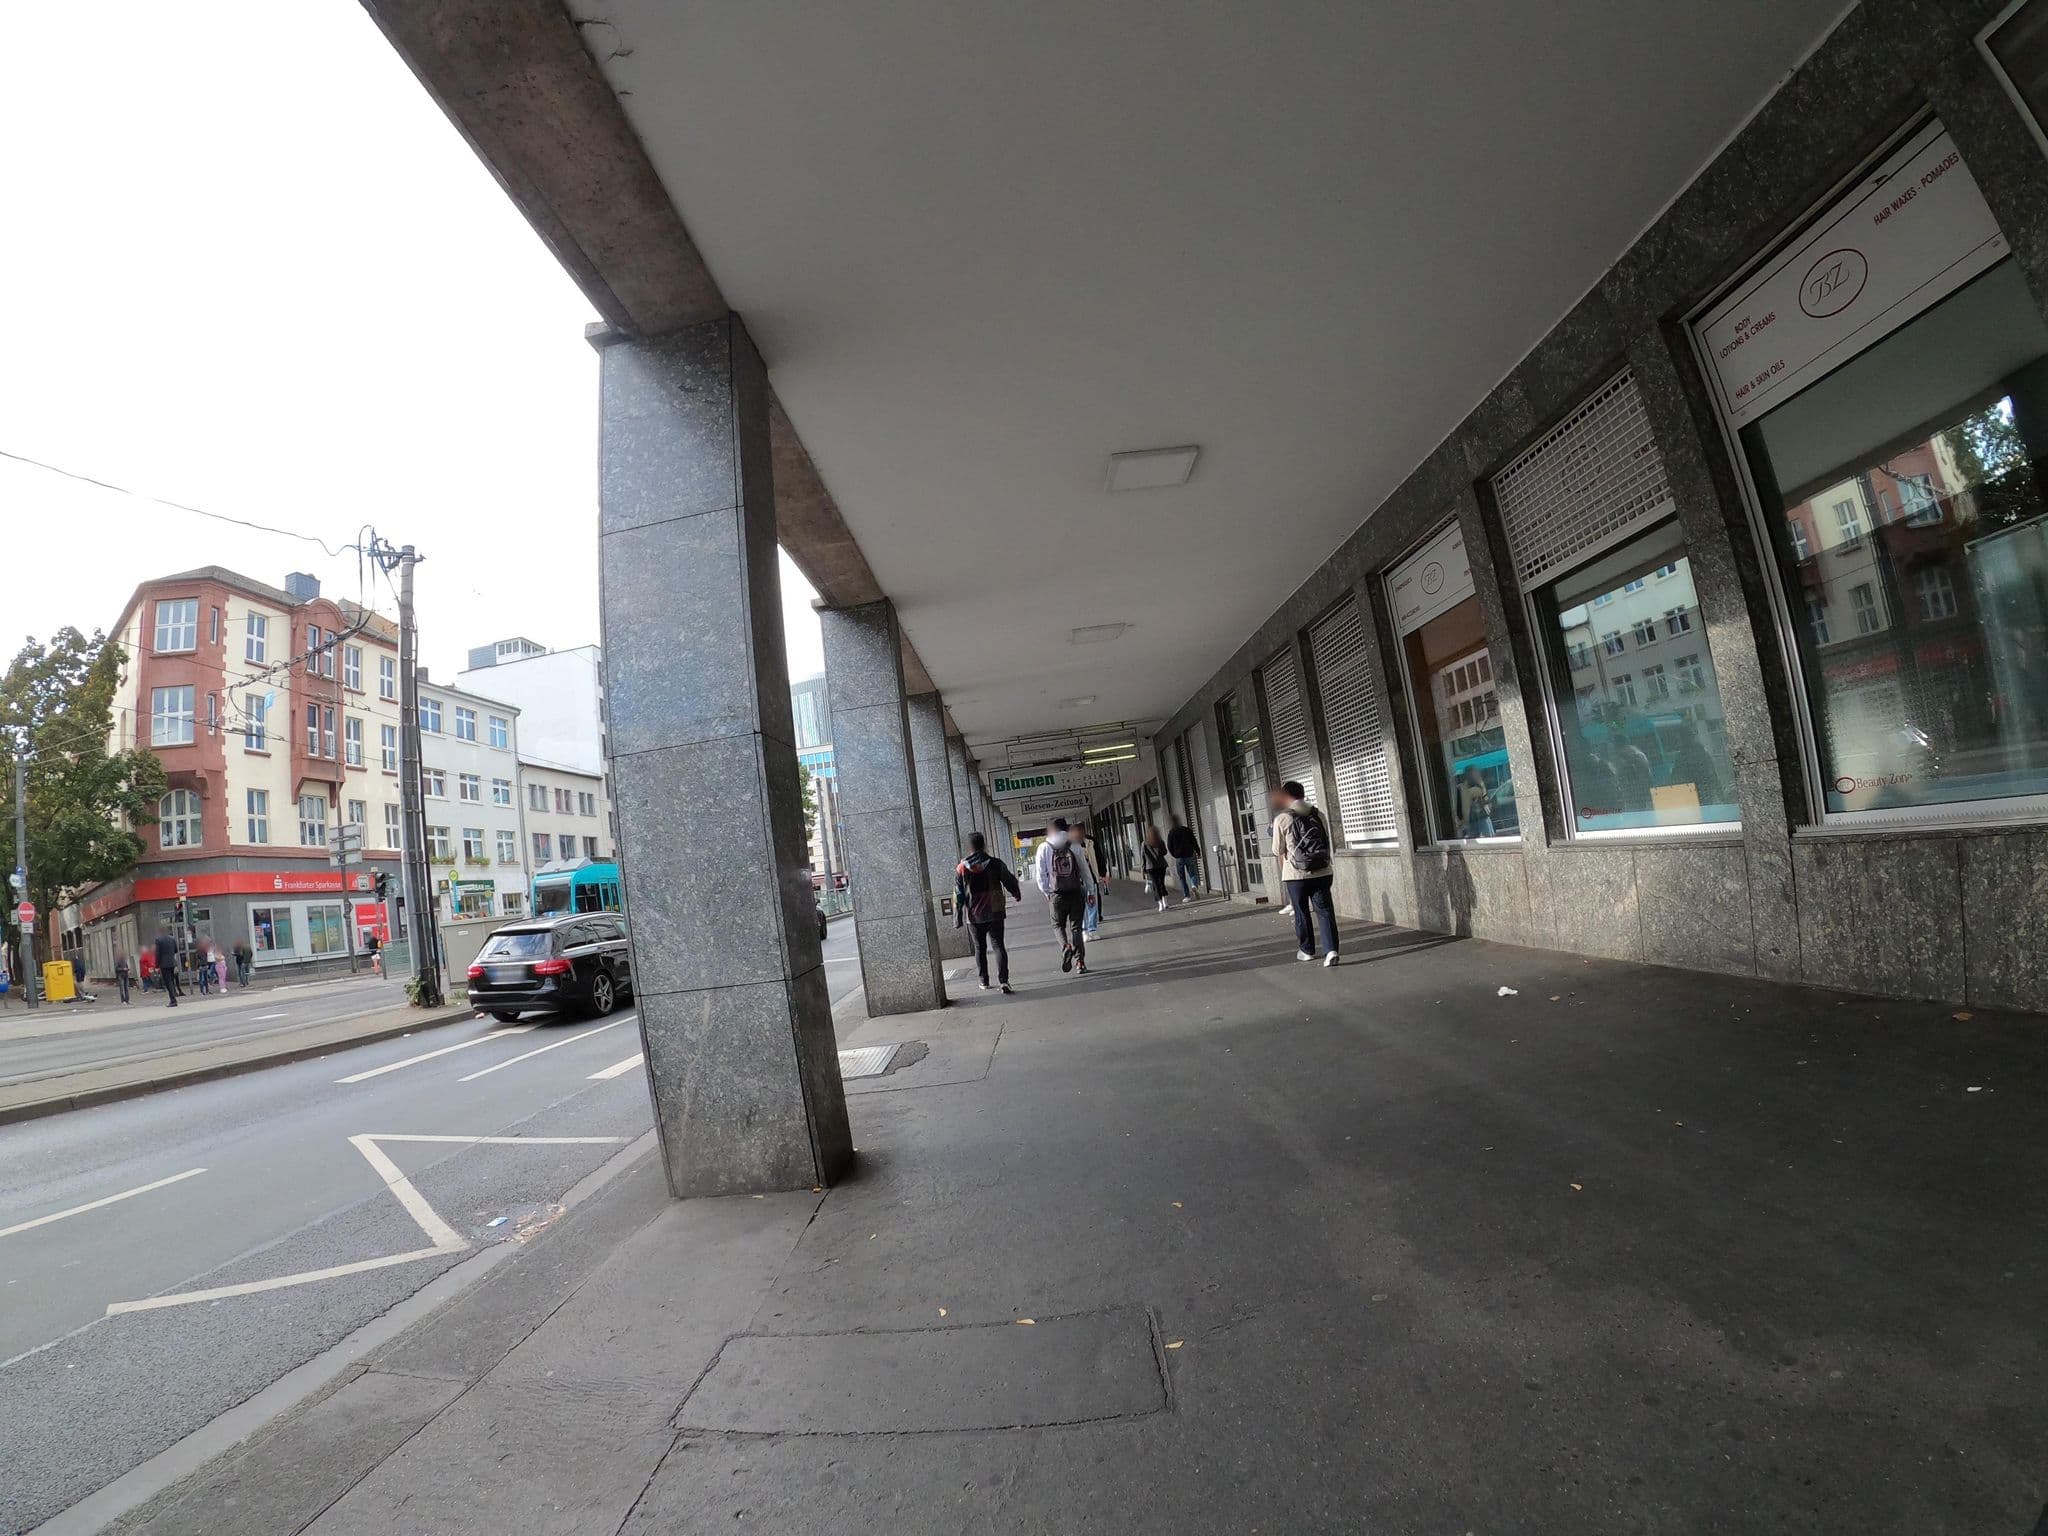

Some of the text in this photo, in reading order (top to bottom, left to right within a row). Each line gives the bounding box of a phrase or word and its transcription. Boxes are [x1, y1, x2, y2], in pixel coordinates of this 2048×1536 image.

[1873, 206, 1892, 226] HAIR
[1890, 186, 1917, 212] WAXES
[1920, 152, 1960, 188] POMADES
[1734, 315, 1752, 334] BODY
[1719, 335, 1745, 359] LOTIONS
[1750, 311, 1776, 336] CREAMS
[1735, 384, 1751, 400] HAIR
[1755, 369, 1771, 386] SKIN
[1770, 359, 1785, 375] OILS
[994, 774, 1055, 793] Blumen
[1856, 776, 1887, 789] Beauty
[284, 881, 315, 890] Frankfurter
[315, 881, 341, 891] Sparkasse
